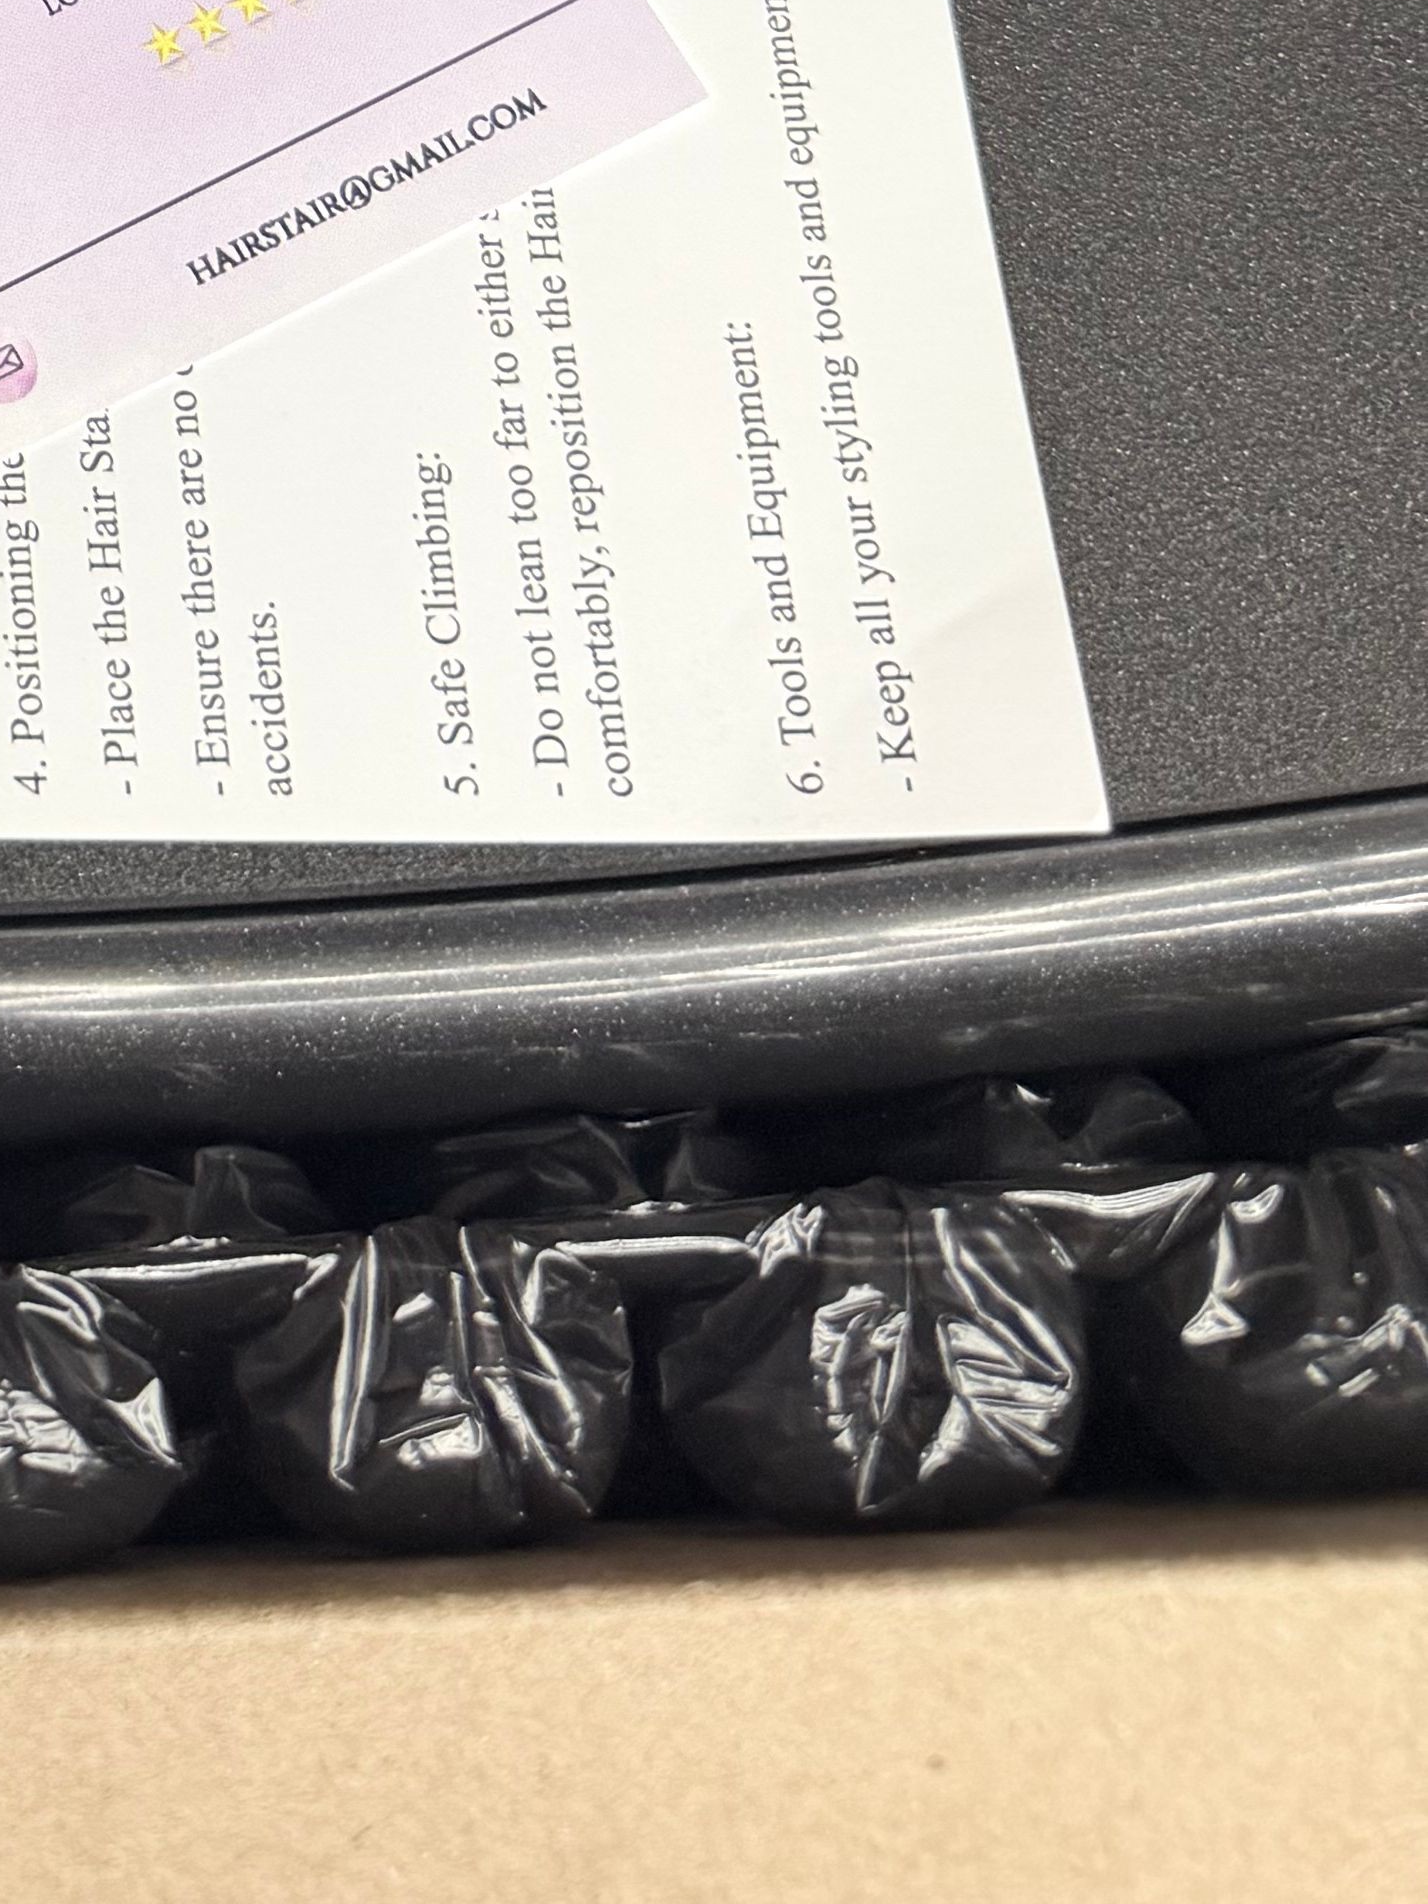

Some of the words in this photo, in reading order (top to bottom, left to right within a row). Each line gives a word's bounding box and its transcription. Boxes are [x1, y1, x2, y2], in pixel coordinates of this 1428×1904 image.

[185, 88, 549, 287] HAIRSTAIR@GMAIL.COM
[783, 177, 827, 242] and
[473, 232, 515, 339] either
[535, 275, 572, 332] the
[799, 254, 845, 344] tools
[491, 351, 521, 388] to
[79, 407, 115, 473] Sta
[173, 389, 201, 437] no
[492, 398, 530, 451] far
[546, 343, 606, 533] reposition
[723, 322, 789, 540] Equipment:
[820, 355, 873, 483] styling
[178, 448, 207, 506] are
[507, 464, 538, 525] too
[82, 485, 123, 574] Hair
[180, 519, 217, 617] there
[411, 452, 461, 646] Climbing:
[846, 495, 896, 585] your
[91, 585, 128, 646] the
[514, 537, 551, 617] lean
[751, 553, 797, 623] and
[523, 630, 561, 694] not
[852, 599, 896, 646] all
[100, 658, 139, 767] Place
[194, 629, 231, 767] Ensure
[247, 601, 294, 797] accidents.
[430, 658, 474, 745] Safe
[571, 545, 634, 798] comfortably,
[767, 636, 817, 747] Tools
[875, 660, 918, 764] Keep
[13, 760, 48, 796] 4.
[443, 762, 480, 797] 5.
[532, 708, 570, 768] Do
[785, 760, 825, 795] 6.
